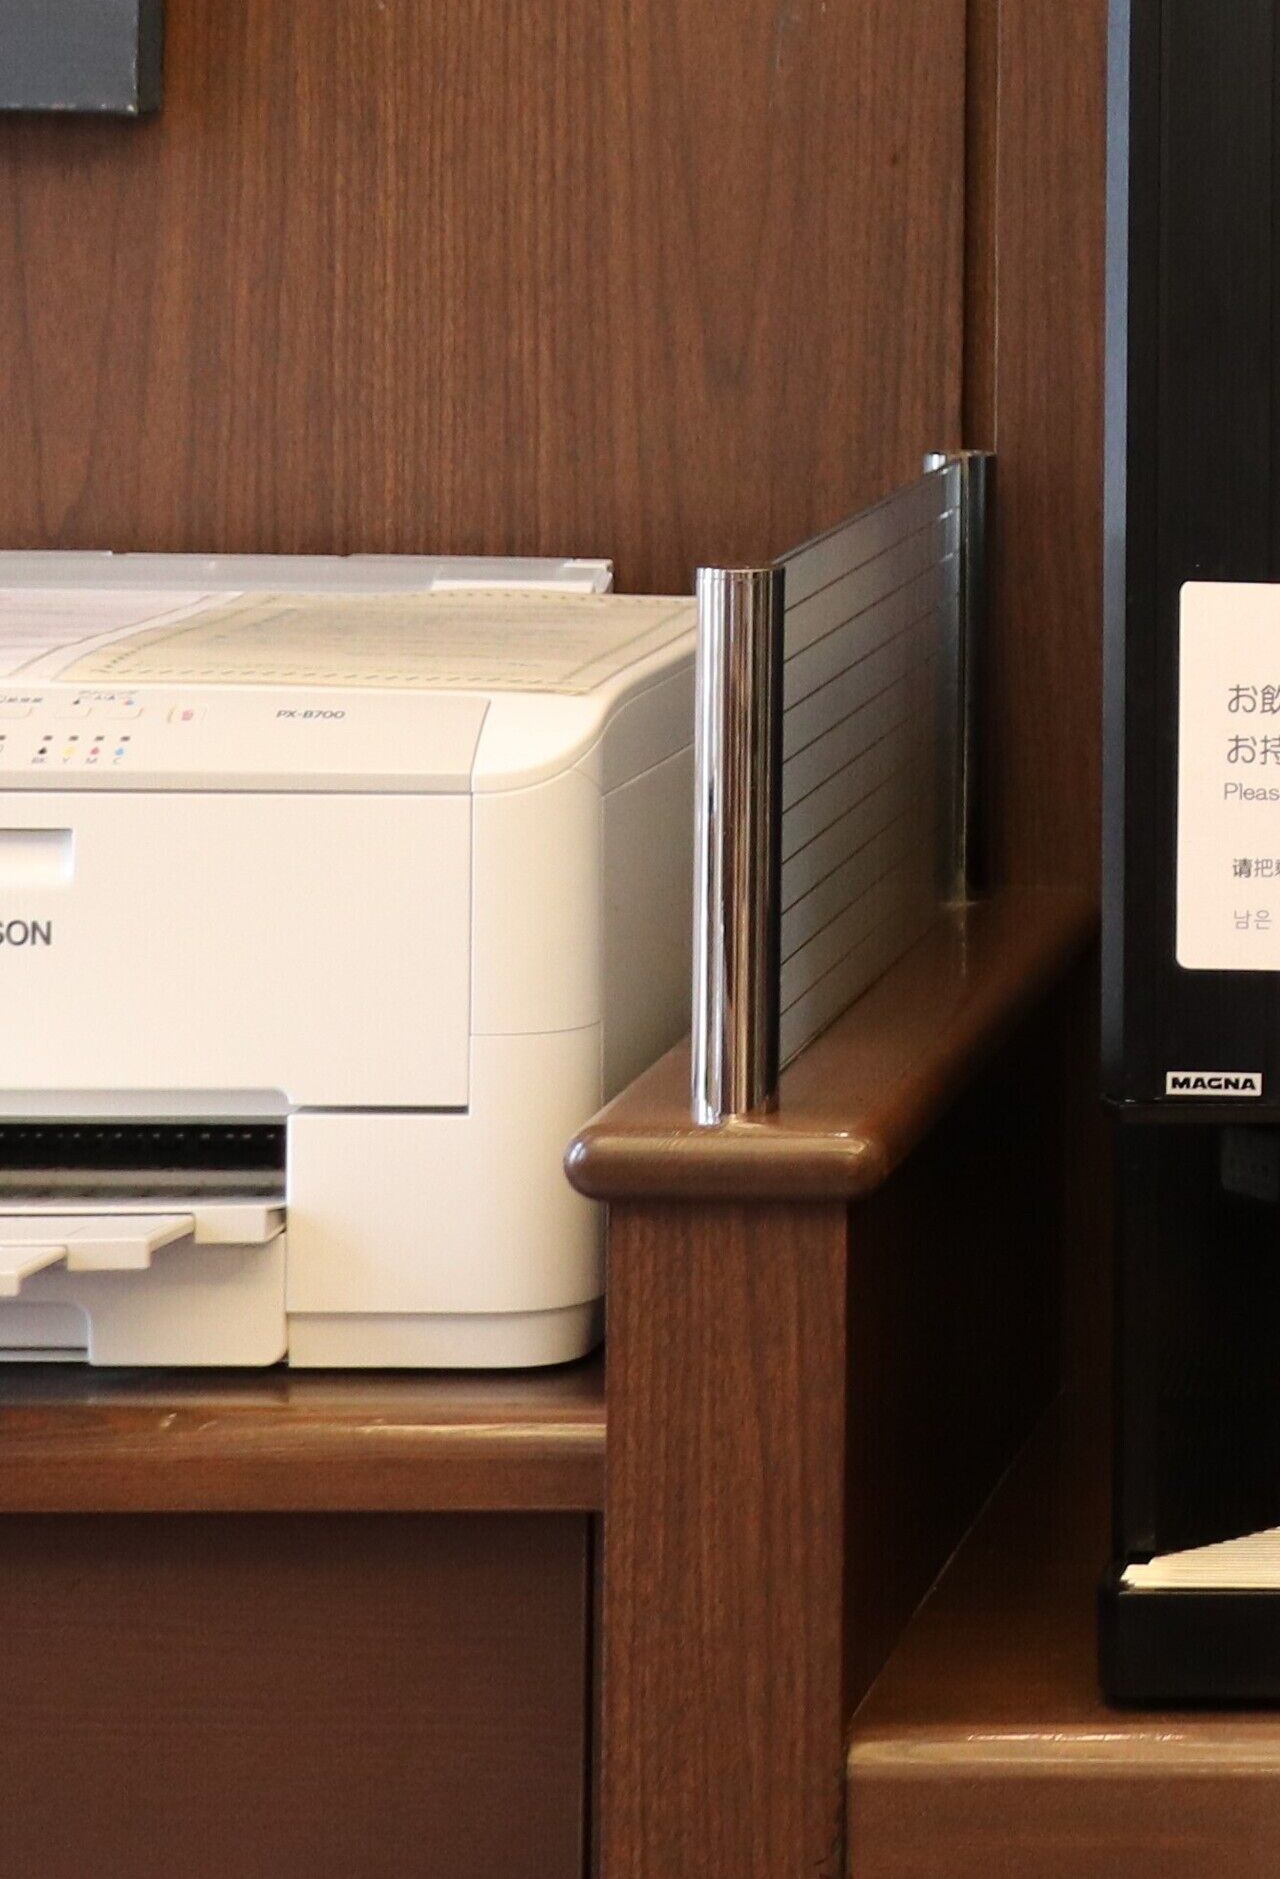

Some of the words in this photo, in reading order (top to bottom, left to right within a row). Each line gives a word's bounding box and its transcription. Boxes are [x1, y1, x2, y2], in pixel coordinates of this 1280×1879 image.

[1233, 910, 1272, 930] 남은
[0, 920, 52, 946] ON
[1171, 1075, 1256, 1092] MAGNA
